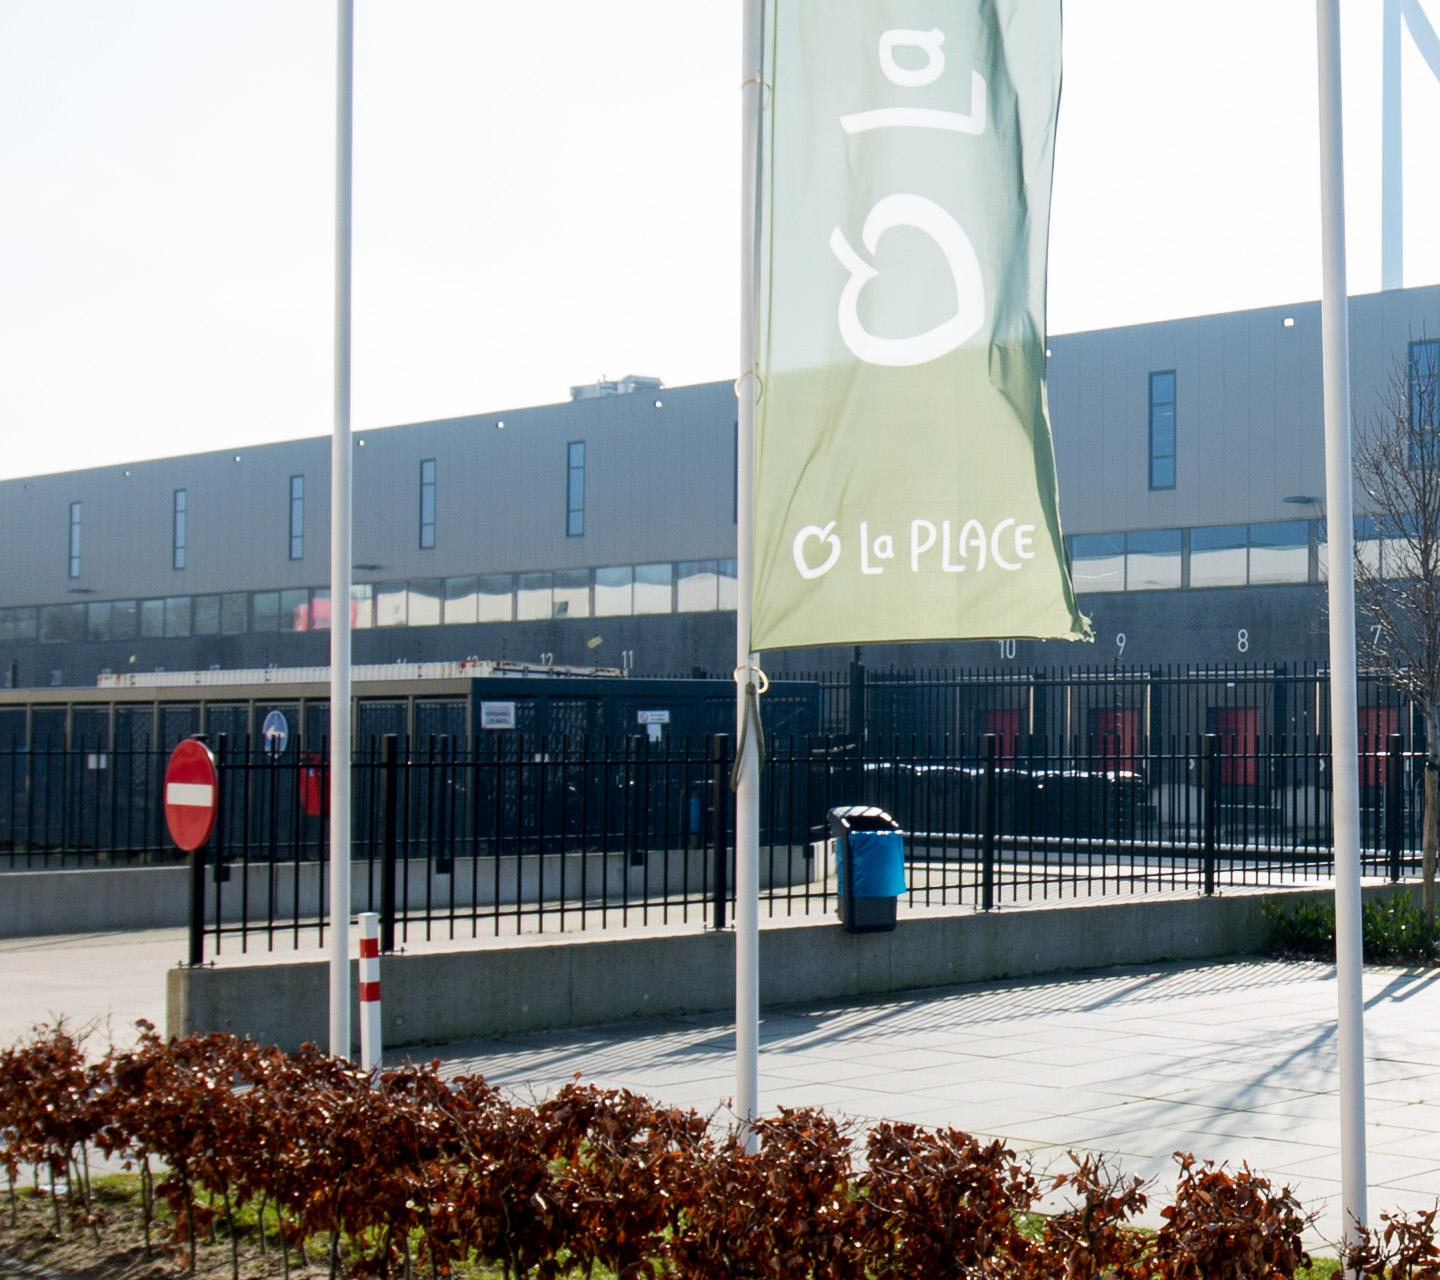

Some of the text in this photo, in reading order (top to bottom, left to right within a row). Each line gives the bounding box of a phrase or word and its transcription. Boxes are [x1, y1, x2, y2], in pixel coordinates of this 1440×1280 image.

[839, 27, 987, 136] La
[860, 518, 1036, 575] La PLACE
[1116, 632, 1127, 656] 9
[1237, 628, 1250, 652] 8
[1370, 624, 1384, 645] 7
[622, 649, 633, 669] 11
[998, 638, 1016, 659] 10
